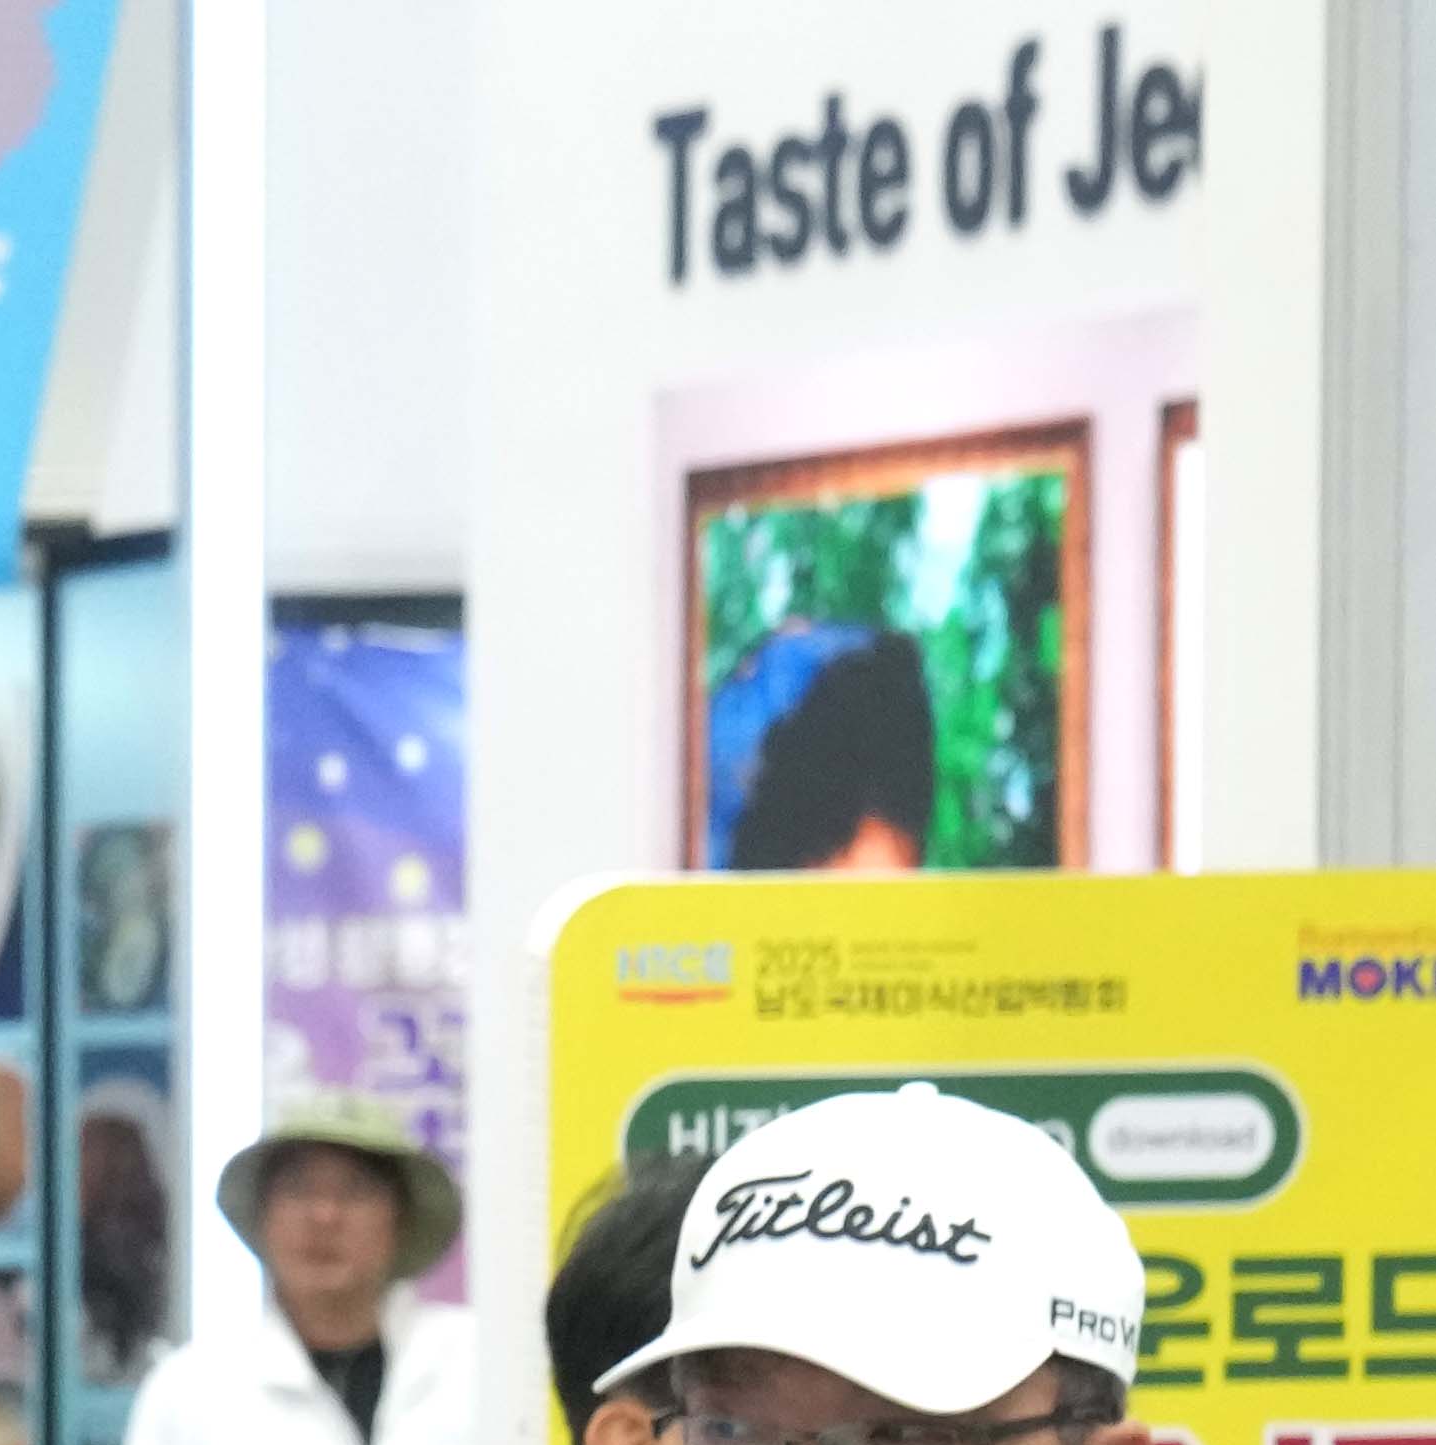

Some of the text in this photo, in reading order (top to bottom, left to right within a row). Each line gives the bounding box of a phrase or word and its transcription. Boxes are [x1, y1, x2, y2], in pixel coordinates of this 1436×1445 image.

[652, 24, 1205, 288] Taste of Je
[1298, 957, 1436, 1000] MOK
[691, 1169, 990, 1269] Titleist
